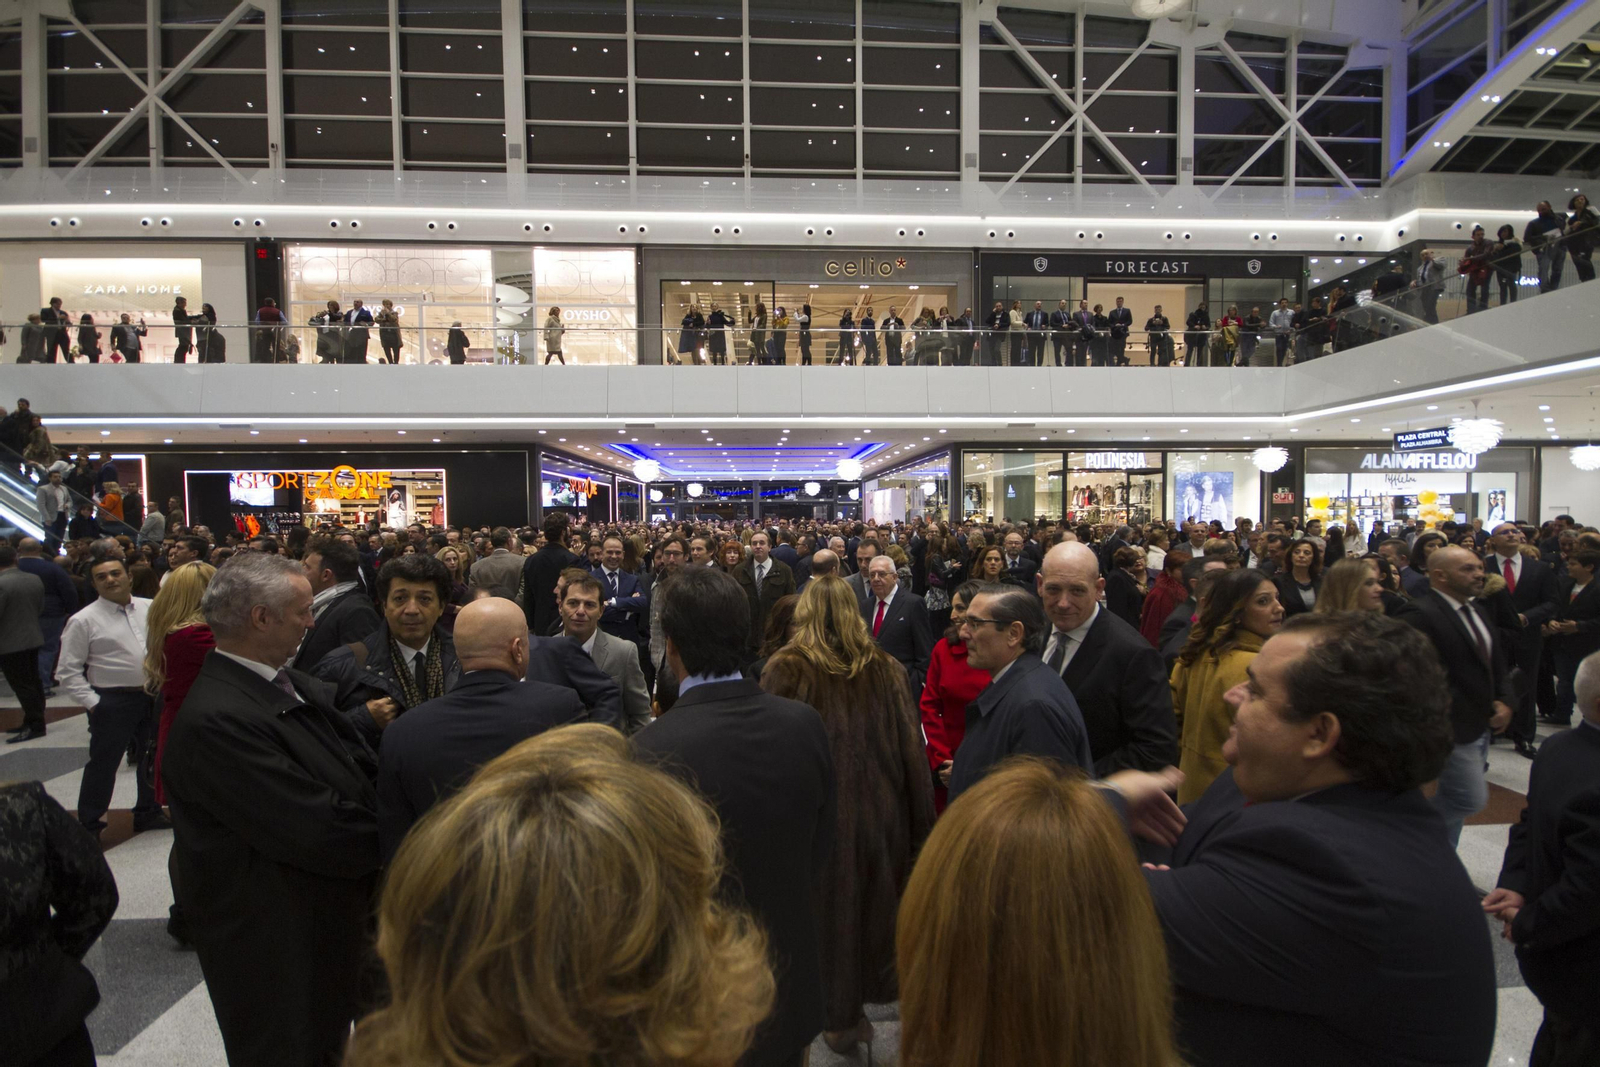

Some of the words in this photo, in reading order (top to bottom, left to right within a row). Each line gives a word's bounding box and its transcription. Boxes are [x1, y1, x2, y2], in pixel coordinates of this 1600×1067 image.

[1105, 261, 1189, 273] FORECAST
[84, 285, 127, 294] ZARA
[136, 285, 182, 294] HOME
[563, 309, 611, 321] OYSHO
[1417, 430, 1447, 440] CENTRAL
[1085, 452, 1146, 469] POLINESIA
